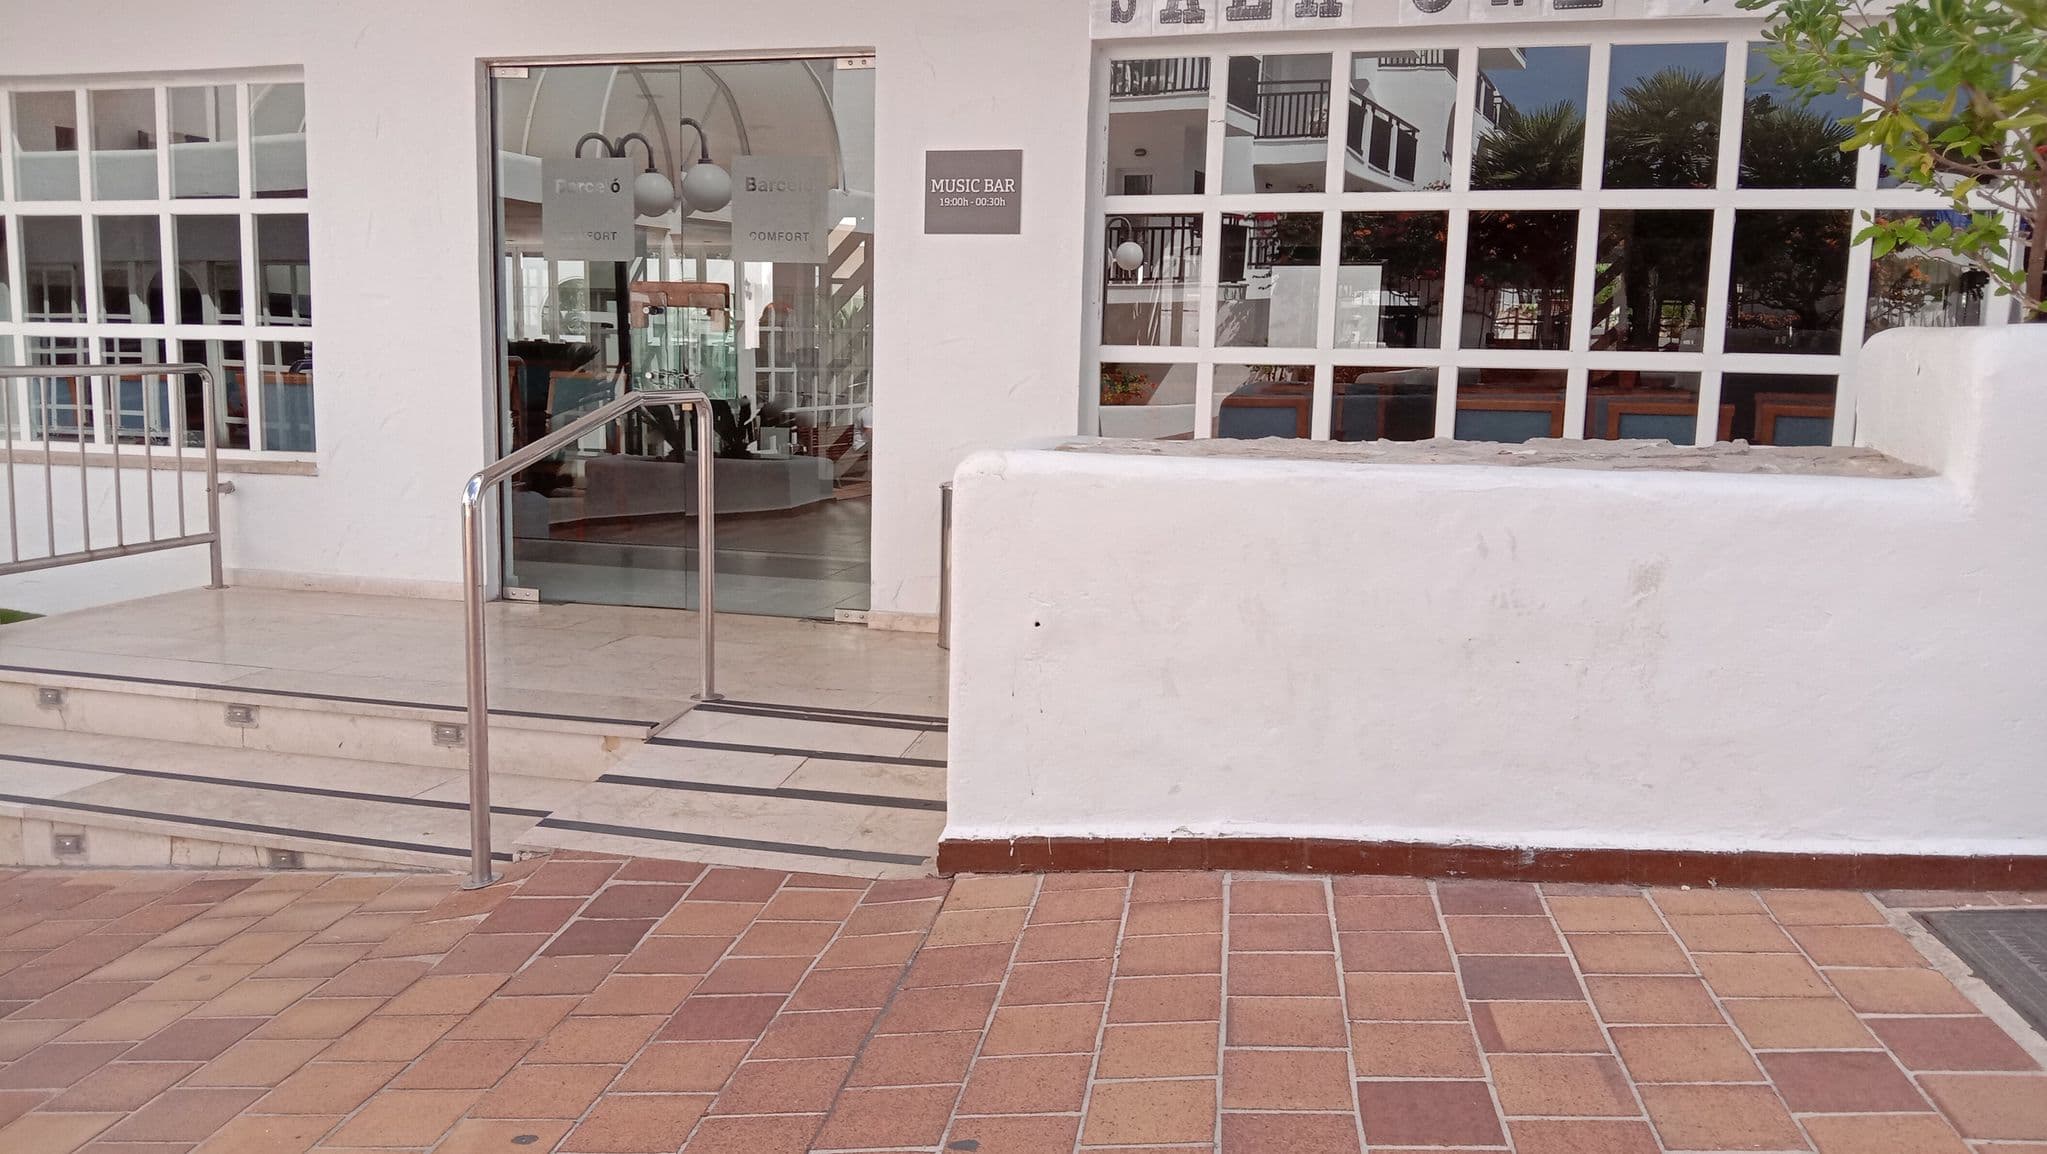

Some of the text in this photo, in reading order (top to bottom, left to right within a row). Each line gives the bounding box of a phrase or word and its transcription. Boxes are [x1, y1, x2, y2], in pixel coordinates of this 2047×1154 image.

[930, 178, 1016, 193] MUSIC BAR
[940, 197, 969, 207] 19:00h
[975, 197, 1006, 207] 00:30h
[749, 231, 809, 241] COMFORT
